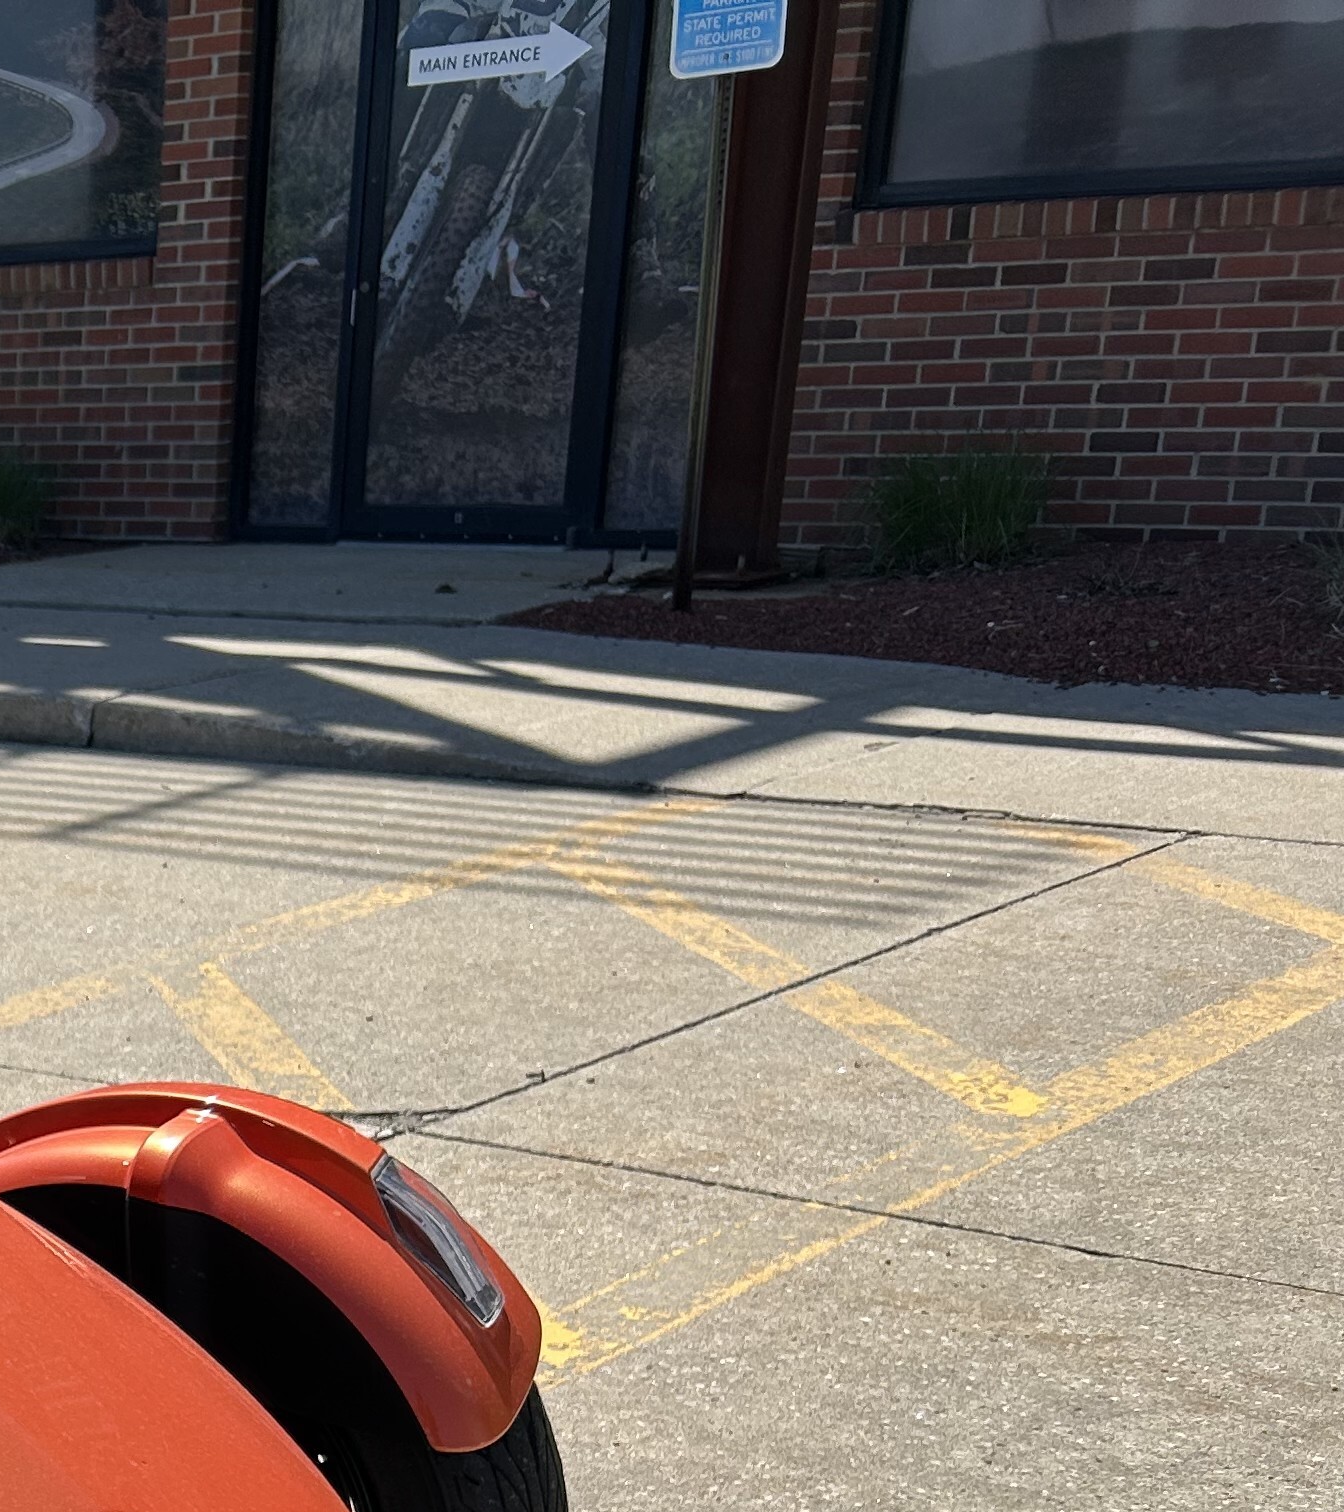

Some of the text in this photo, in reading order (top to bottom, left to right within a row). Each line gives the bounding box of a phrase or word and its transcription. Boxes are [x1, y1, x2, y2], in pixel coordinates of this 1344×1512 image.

[683, 8, 776, 33] STATE PERMIT
[695, 26, 761, 47] REQUIRED
[419, 46, 541, 73] MAIN ENTRANCE
